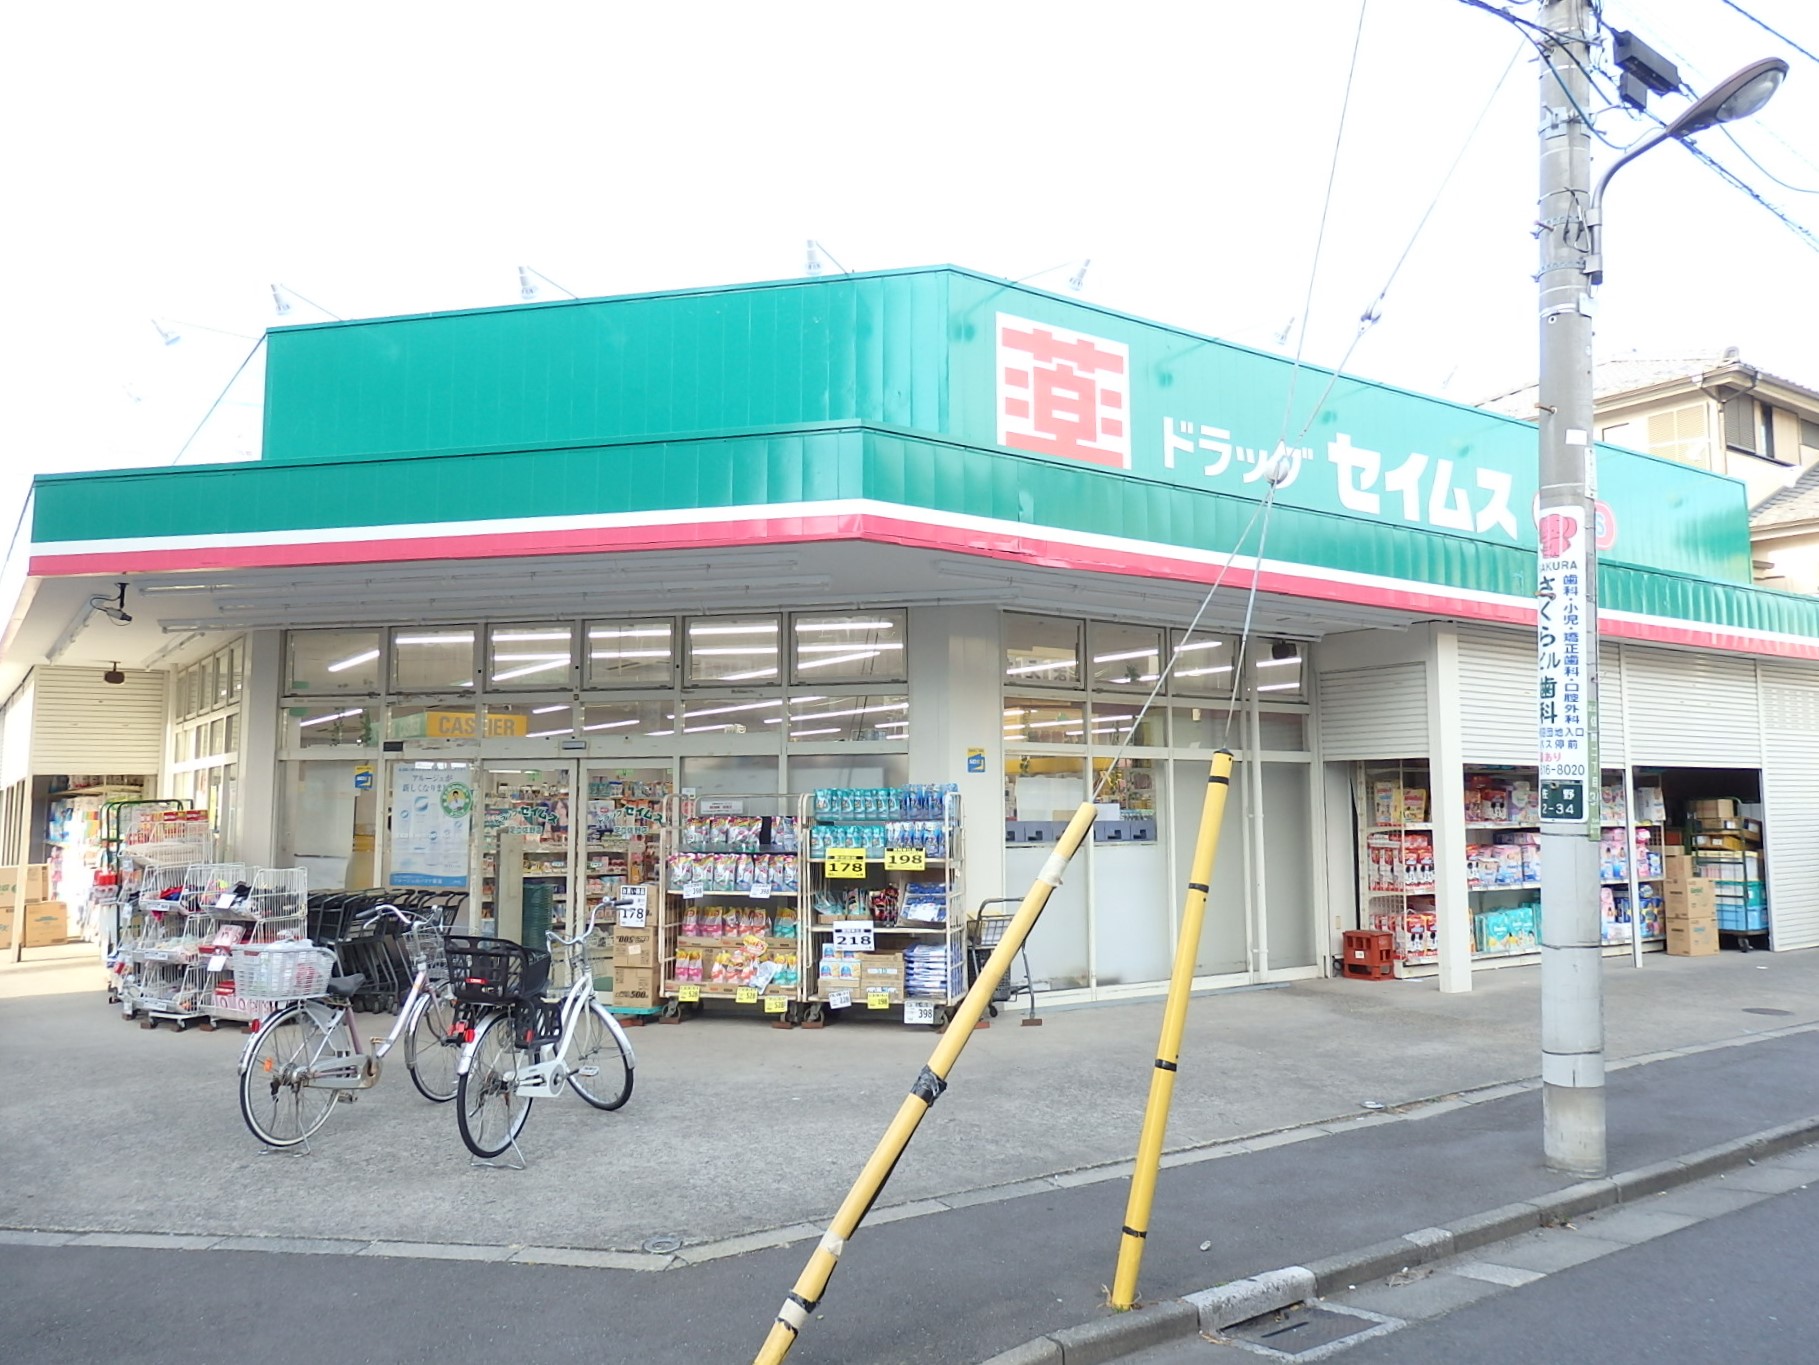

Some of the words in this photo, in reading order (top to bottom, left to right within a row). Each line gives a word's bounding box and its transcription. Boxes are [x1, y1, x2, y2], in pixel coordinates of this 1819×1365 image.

[1001, 327, 1124, 469] 薬
[1163, 416, 1313, 489] ドラッグ
[1327, 432, 1518, 541] セイムス
[438, 714, 516, 737] CASIER
[889, 854, 923, 865] 198
[829, 862, 863, 873] 178
[836, 935, 872, 946] 218
[918, 1008, 933, 1019] 398
